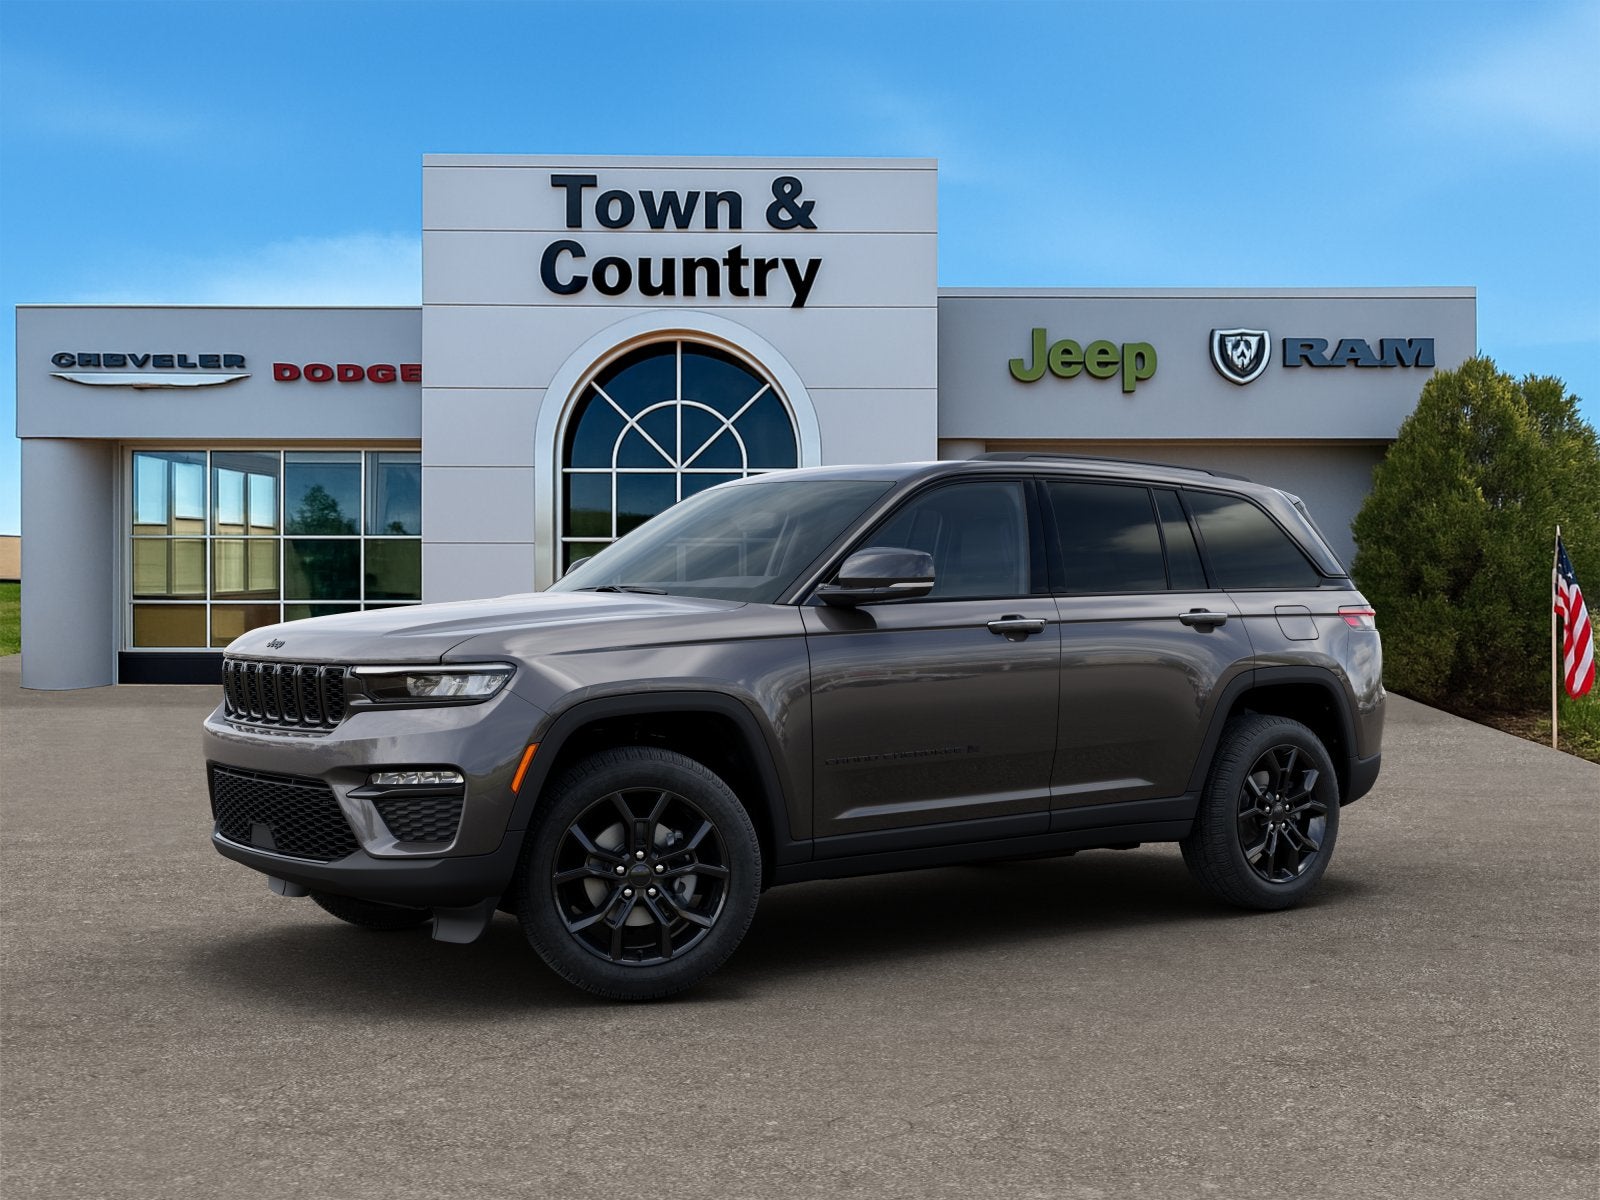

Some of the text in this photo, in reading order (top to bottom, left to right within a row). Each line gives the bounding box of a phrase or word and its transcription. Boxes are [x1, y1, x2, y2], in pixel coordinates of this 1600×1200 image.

[551, 174, 818, 230] Town &
[540, 239, 822, 308] Country
[272, 362, 422, 383] DODGE
[1009, 328, 1157, 392] Jeep
[1283, 337, 1436, 367] RAM
